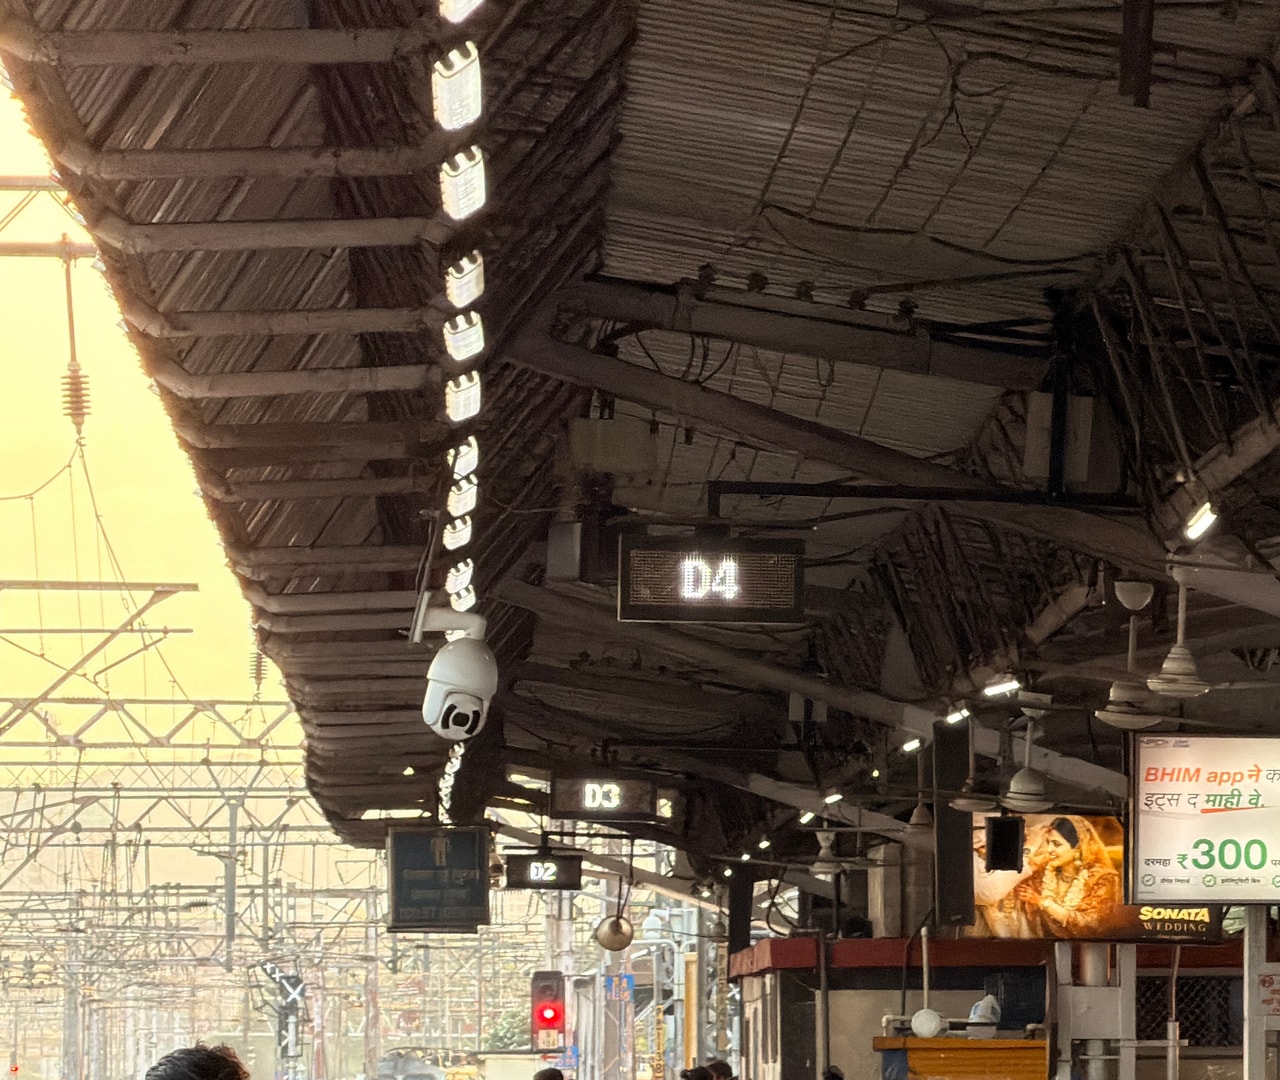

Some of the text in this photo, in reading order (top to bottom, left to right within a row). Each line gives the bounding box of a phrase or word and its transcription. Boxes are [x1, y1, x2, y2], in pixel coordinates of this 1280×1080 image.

[681, 556, 741, 600] D4
[1144, 766, 1202, 783] BHIM
[1206, 770, 1245, 786] app
[1248, 763, 1262, 783] ने
[584, 783, 621, 808] D3
[1144, 788, 1265, 811] इट्स द माही वे.
[530, 862, 558, 881] D2
[1144, 858, 1171, 867] दरमहा
[1139, 906, 1211, 923] SONATA
[1143, 922, 1207, 932] WEDDING
